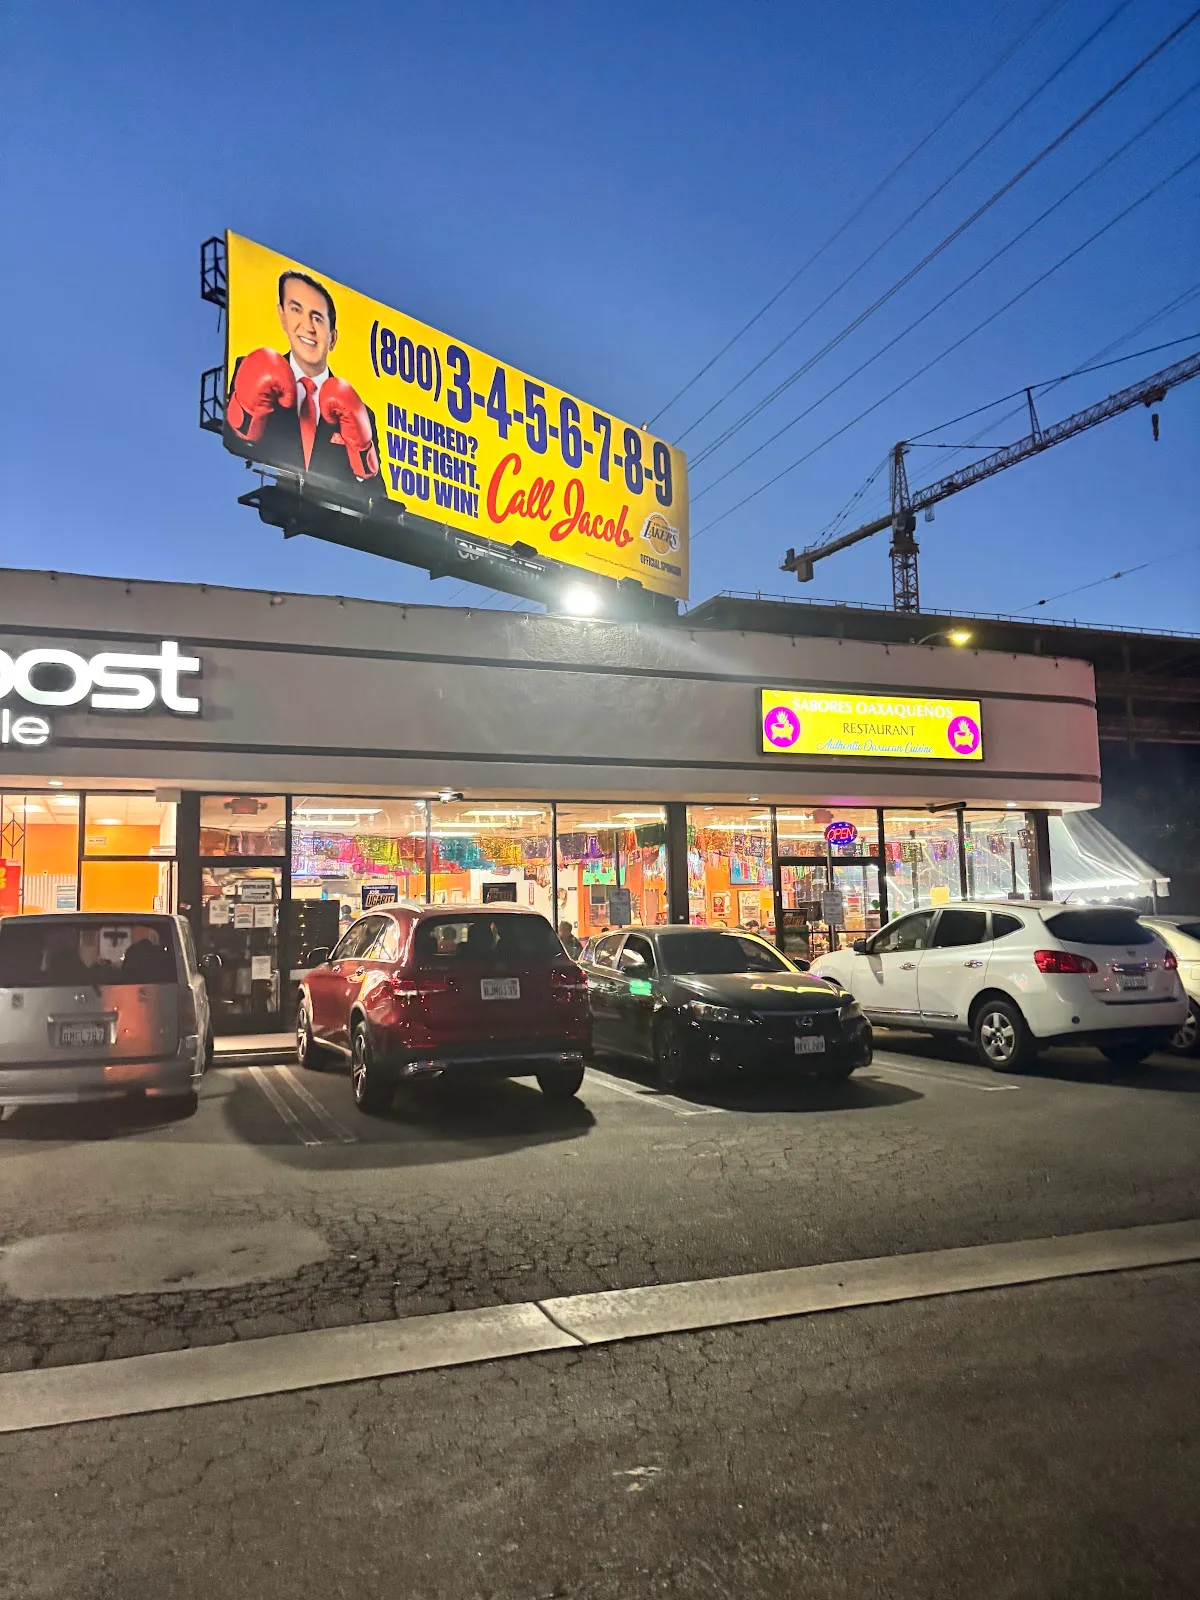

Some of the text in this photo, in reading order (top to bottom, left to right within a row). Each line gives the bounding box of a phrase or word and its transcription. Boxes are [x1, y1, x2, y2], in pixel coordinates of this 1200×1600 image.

[369, 320, 442, 402] (800)
[387, 402, 479, 460] INJURED?
[386, 430, 481, 490] WE FIGHT.
[388, 462, 479, 518] YOU WIN!
[486, 453, 634, 548] Call Jacob
[643, 520, 679, 550] LAKERS
[792, 698, 954, 719] SABORES OAXAQUEÑOS
[842, 722, 916, 737] RESTAURANT
[816, 738, 934, 754] Authentic Oaxacan Cuisine
[826, 826, 855, 841] OPEN
